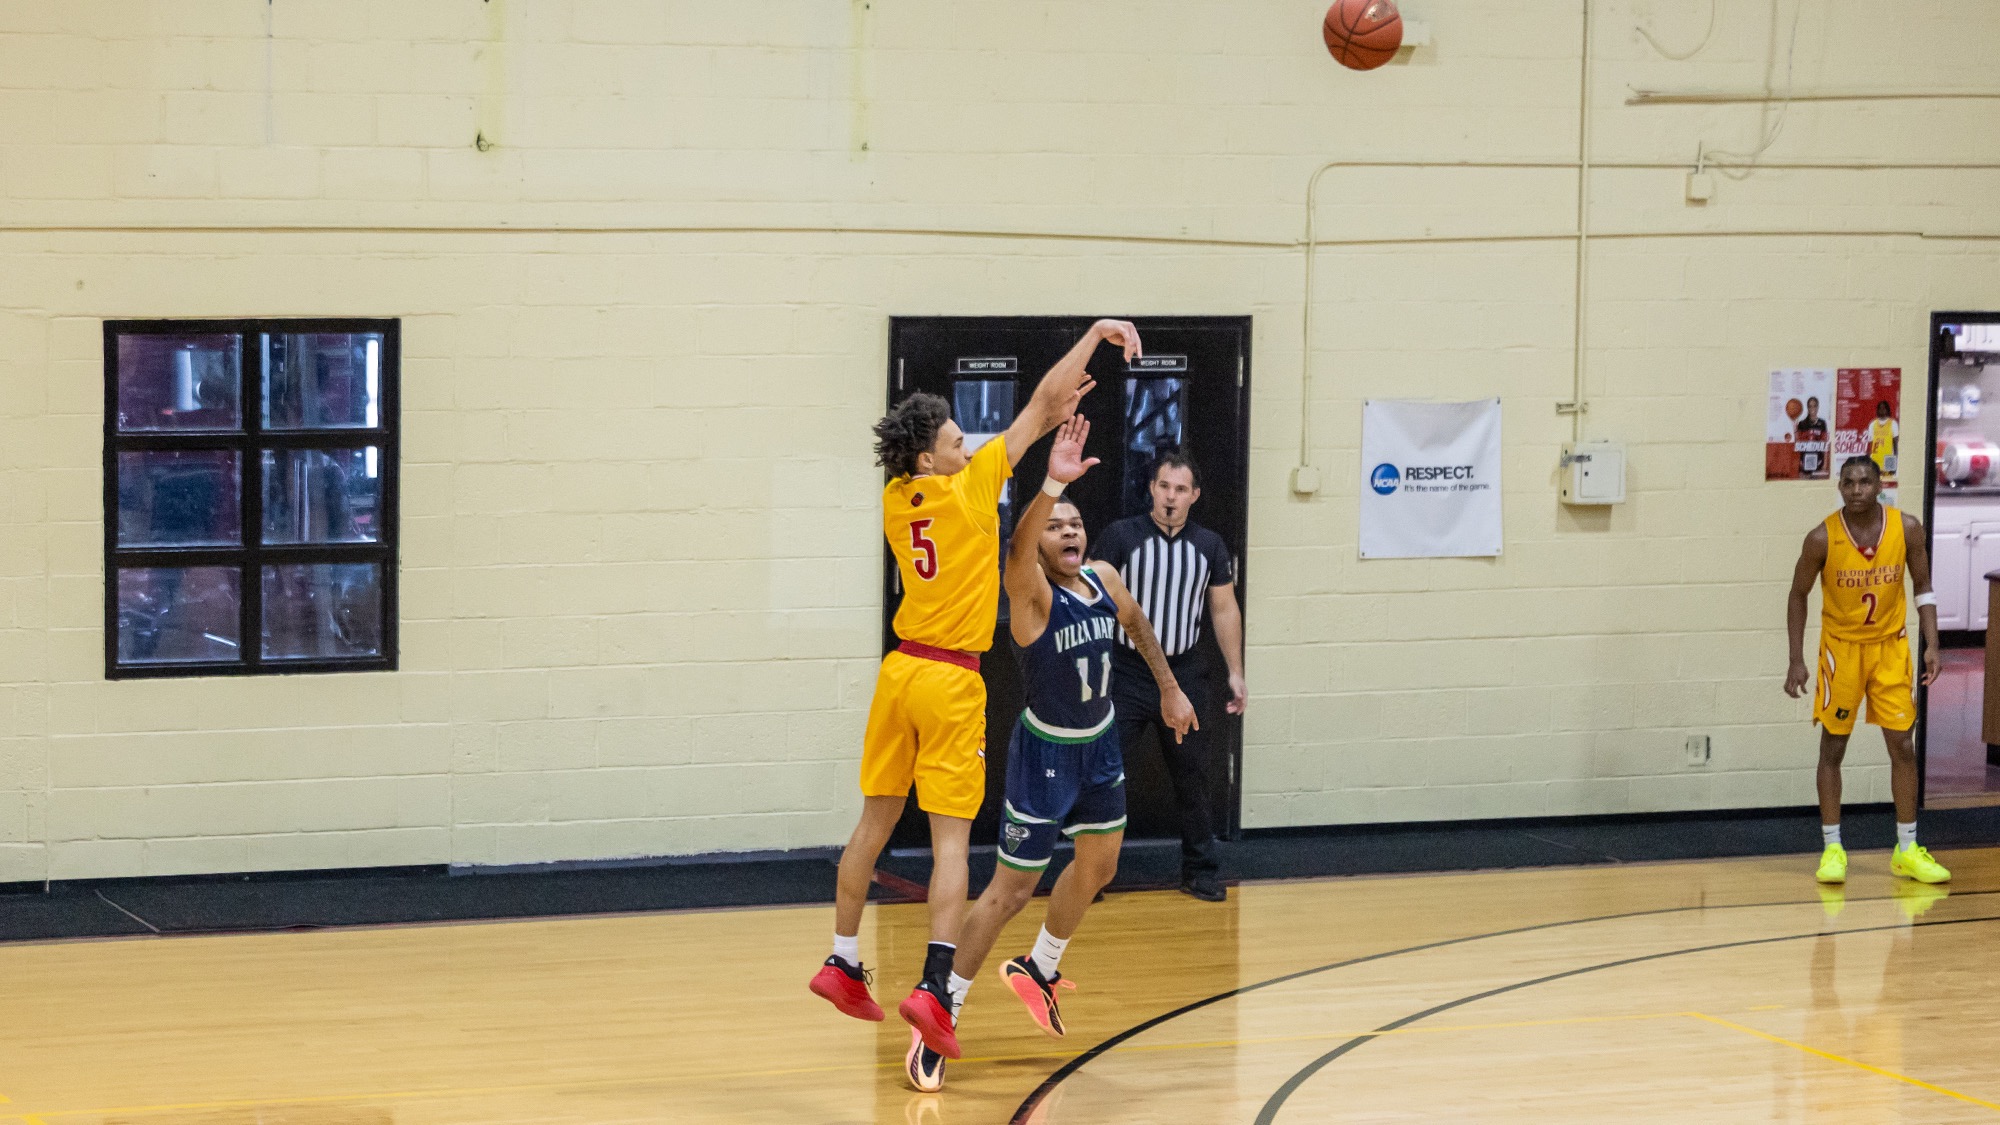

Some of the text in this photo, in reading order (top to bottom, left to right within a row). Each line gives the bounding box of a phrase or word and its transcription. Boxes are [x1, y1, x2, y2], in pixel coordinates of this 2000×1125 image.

[1405, 465, 1475, 481] RESPECT.
[1373, 477, 1401, 488] NCAA
[1404, 484, 1415, 492] It's
[1416, 484, 1429, 492] the
[1450, 483, 1458, 491] of
[1458, 483, 1469, 491] the
[1469, 483, 1492, 493] game.
[909, 517, 939, 582] 5
[1836, 564, 1901, 578] BLOOMFIELD
[1836, 573, 1901, 588] COLLEGE
[1861, 591, 1877, 627] 2
[1054, 620, 1093, 654] VILLA
[1076, 651, 1112, 702] 11
